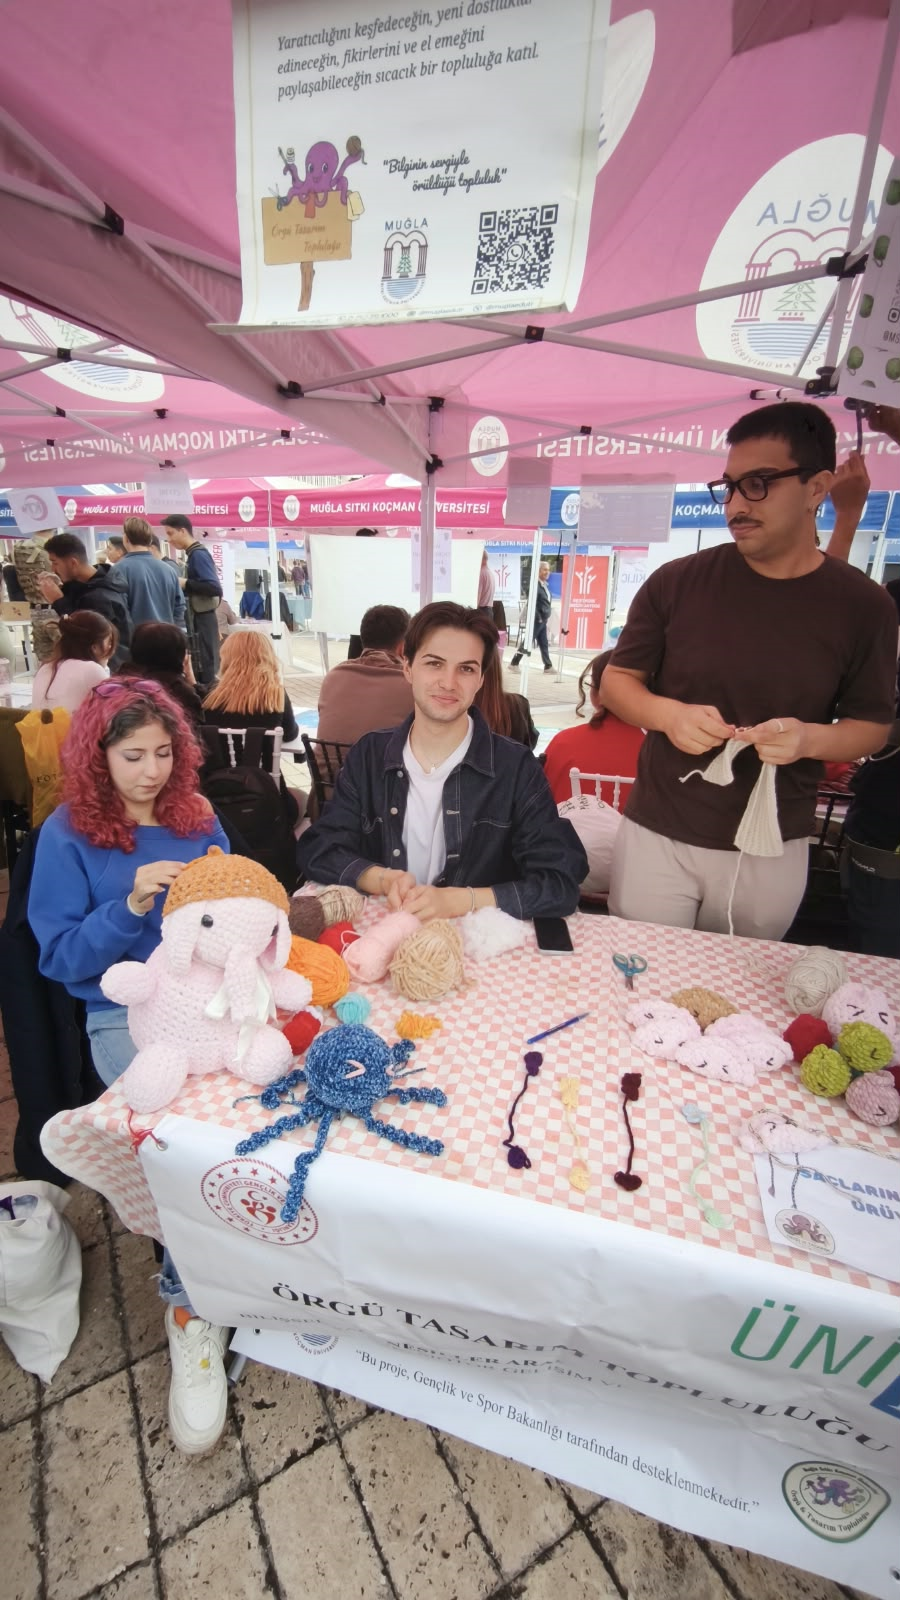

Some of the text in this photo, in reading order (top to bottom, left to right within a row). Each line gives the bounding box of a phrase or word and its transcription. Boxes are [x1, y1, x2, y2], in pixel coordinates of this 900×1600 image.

[277, 27, 351, 51] Yaratıcılığını
[354, 10, 433, 40] keşfedeceğin,
[435, 1, 464, 27] yeni
[277, 25, 485, 74] edineceğin, fikirlerini ve el emeğini
[278, 41, 539, 102] paylaşabileceğin sıcacık bir topluluğa katıl.
[430, 149, 470, 174] sevgiyle
[412, 174, 456, 196] örüldüğü
[385, 217, 428, 231] MUĞLA
[83, 504, 109, 514] MUĞLA
[111, 505, 131, 514] SITKI
[310, 501, 490, 514] MUĞLA SITKI KOÇMAN VERSİTESİ
[674, 503, 725, 518] KOÇMA
[272, 1282, 894, 1452] ÖRGÜ TASARIM TOPLULUĞU
[379, 1360, 410, 1380] proje,
[413, 1370, 456, 1397] Gençlik
[460, 1390, 474, 1403] ve
[476, 1393, 505, 1415] Spor
[506, 1405, 563, 1441] Bakanlığı
[566, 1430, 628, 1466] tarafından
[807, 1512, 837, 1532] Tasarım
